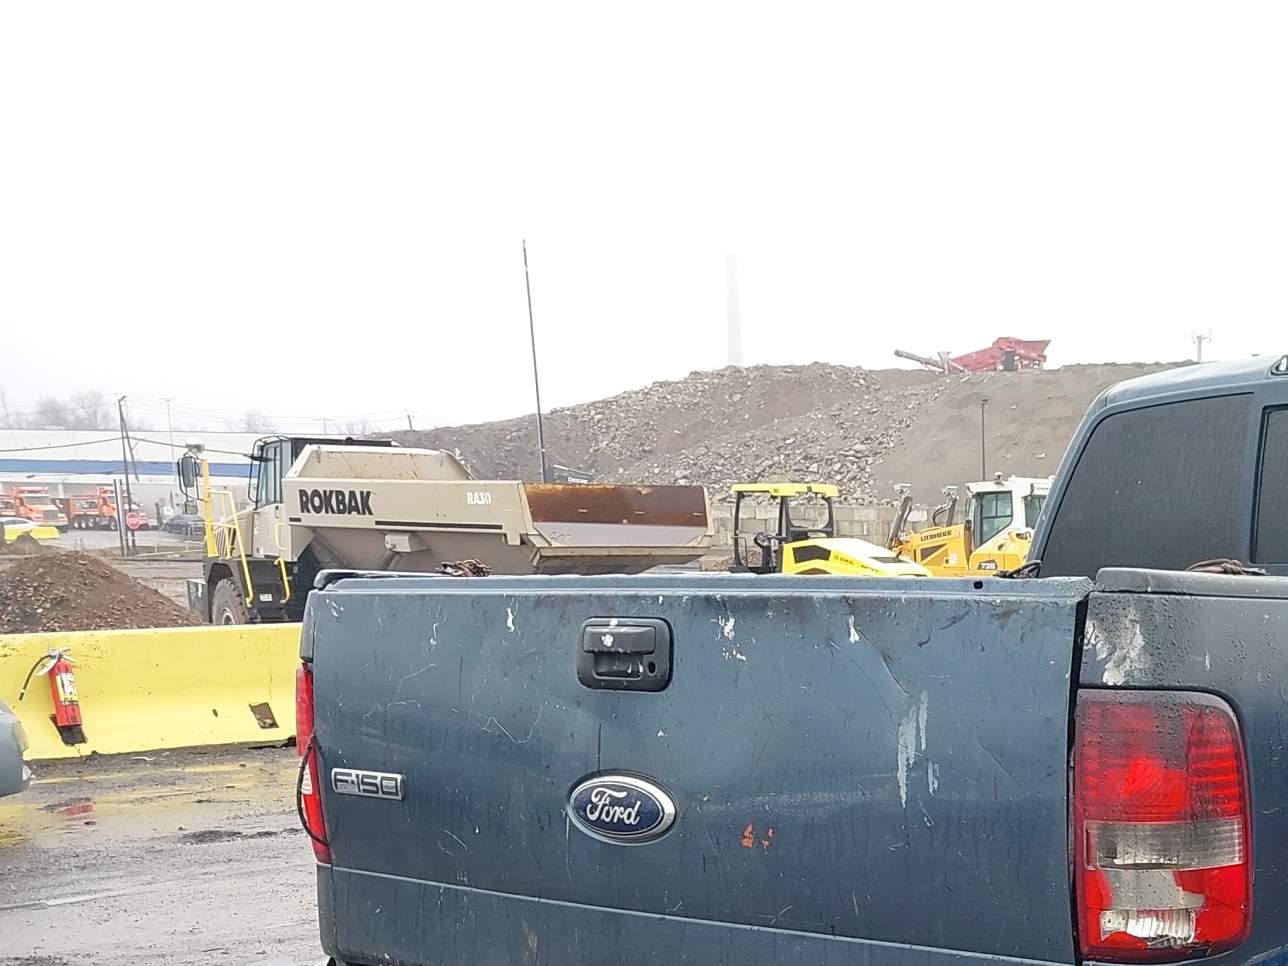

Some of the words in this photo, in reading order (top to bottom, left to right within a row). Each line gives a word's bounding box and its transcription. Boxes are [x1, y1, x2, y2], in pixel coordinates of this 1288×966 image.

[298, 488, 374, 516] ROKBAK
[466, 491, 492, 505] RA30
[333, 771, 400, 796] F-150
[586, 788, 642, 825] Ford
